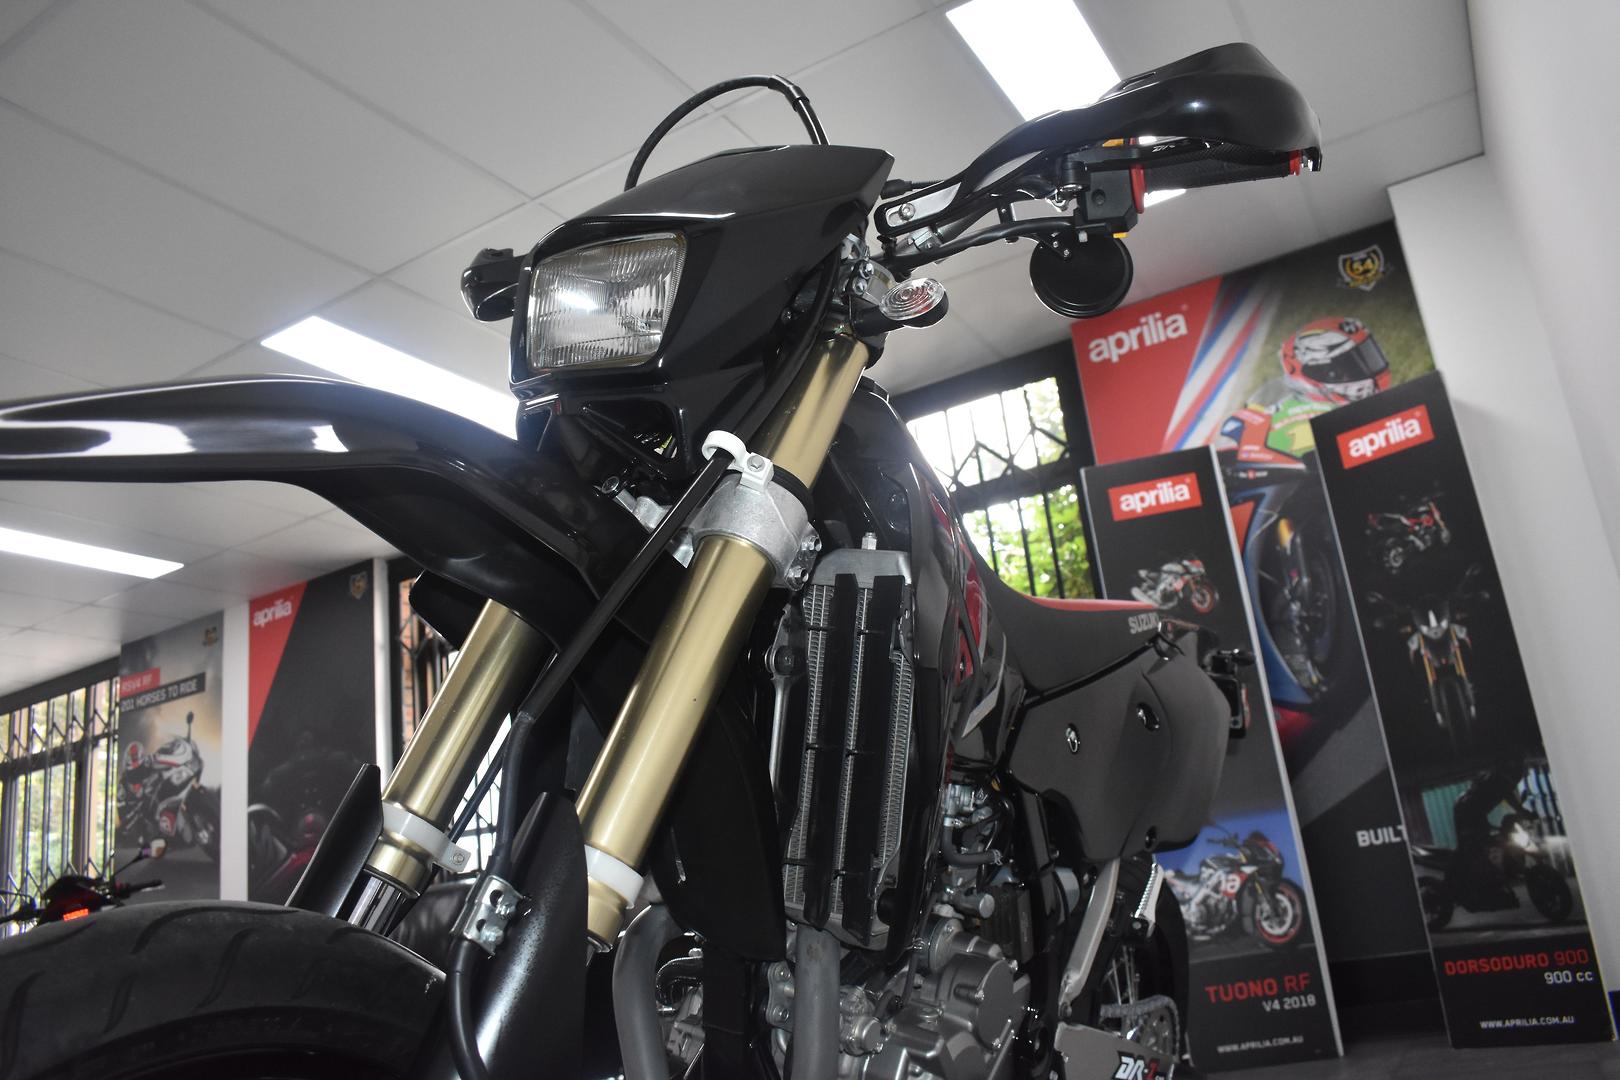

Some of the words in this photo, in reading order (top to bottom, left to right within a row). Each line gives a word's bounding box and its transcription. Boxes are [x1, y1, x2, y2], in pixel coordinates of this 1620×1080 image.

[1088, 309, 1189, 364] aprilia
[1347, 413, 1422, 460] aprilia
[1119, 480, 1191, 514] aprilia
[253, 599, 292, 628] aprilia
[136, 688, 167, 707] HORSES
[168, 684, 179, 698] TO
[180, 678, 198, 695] RIDE
[1444, 953, 1549, 976] DORSODURO
[1554, 948, 1590, 967] 900
[1205, 978, 1278, 1004] TUONO
[1284, 972, 1311, 993] RF
[1544, 970, 1572, 985] 900
[1576, 971, 1594, 982] cc
[1262, 999, 1281, 1012] V4
[1283, 994, 1316, 1010] 2018
[1480, 1015, 1575, 1029] WWW.APRILIA.COM.AU
[1217, 1035, 1304, 1054] WWW.APRILIA.COM.AU
